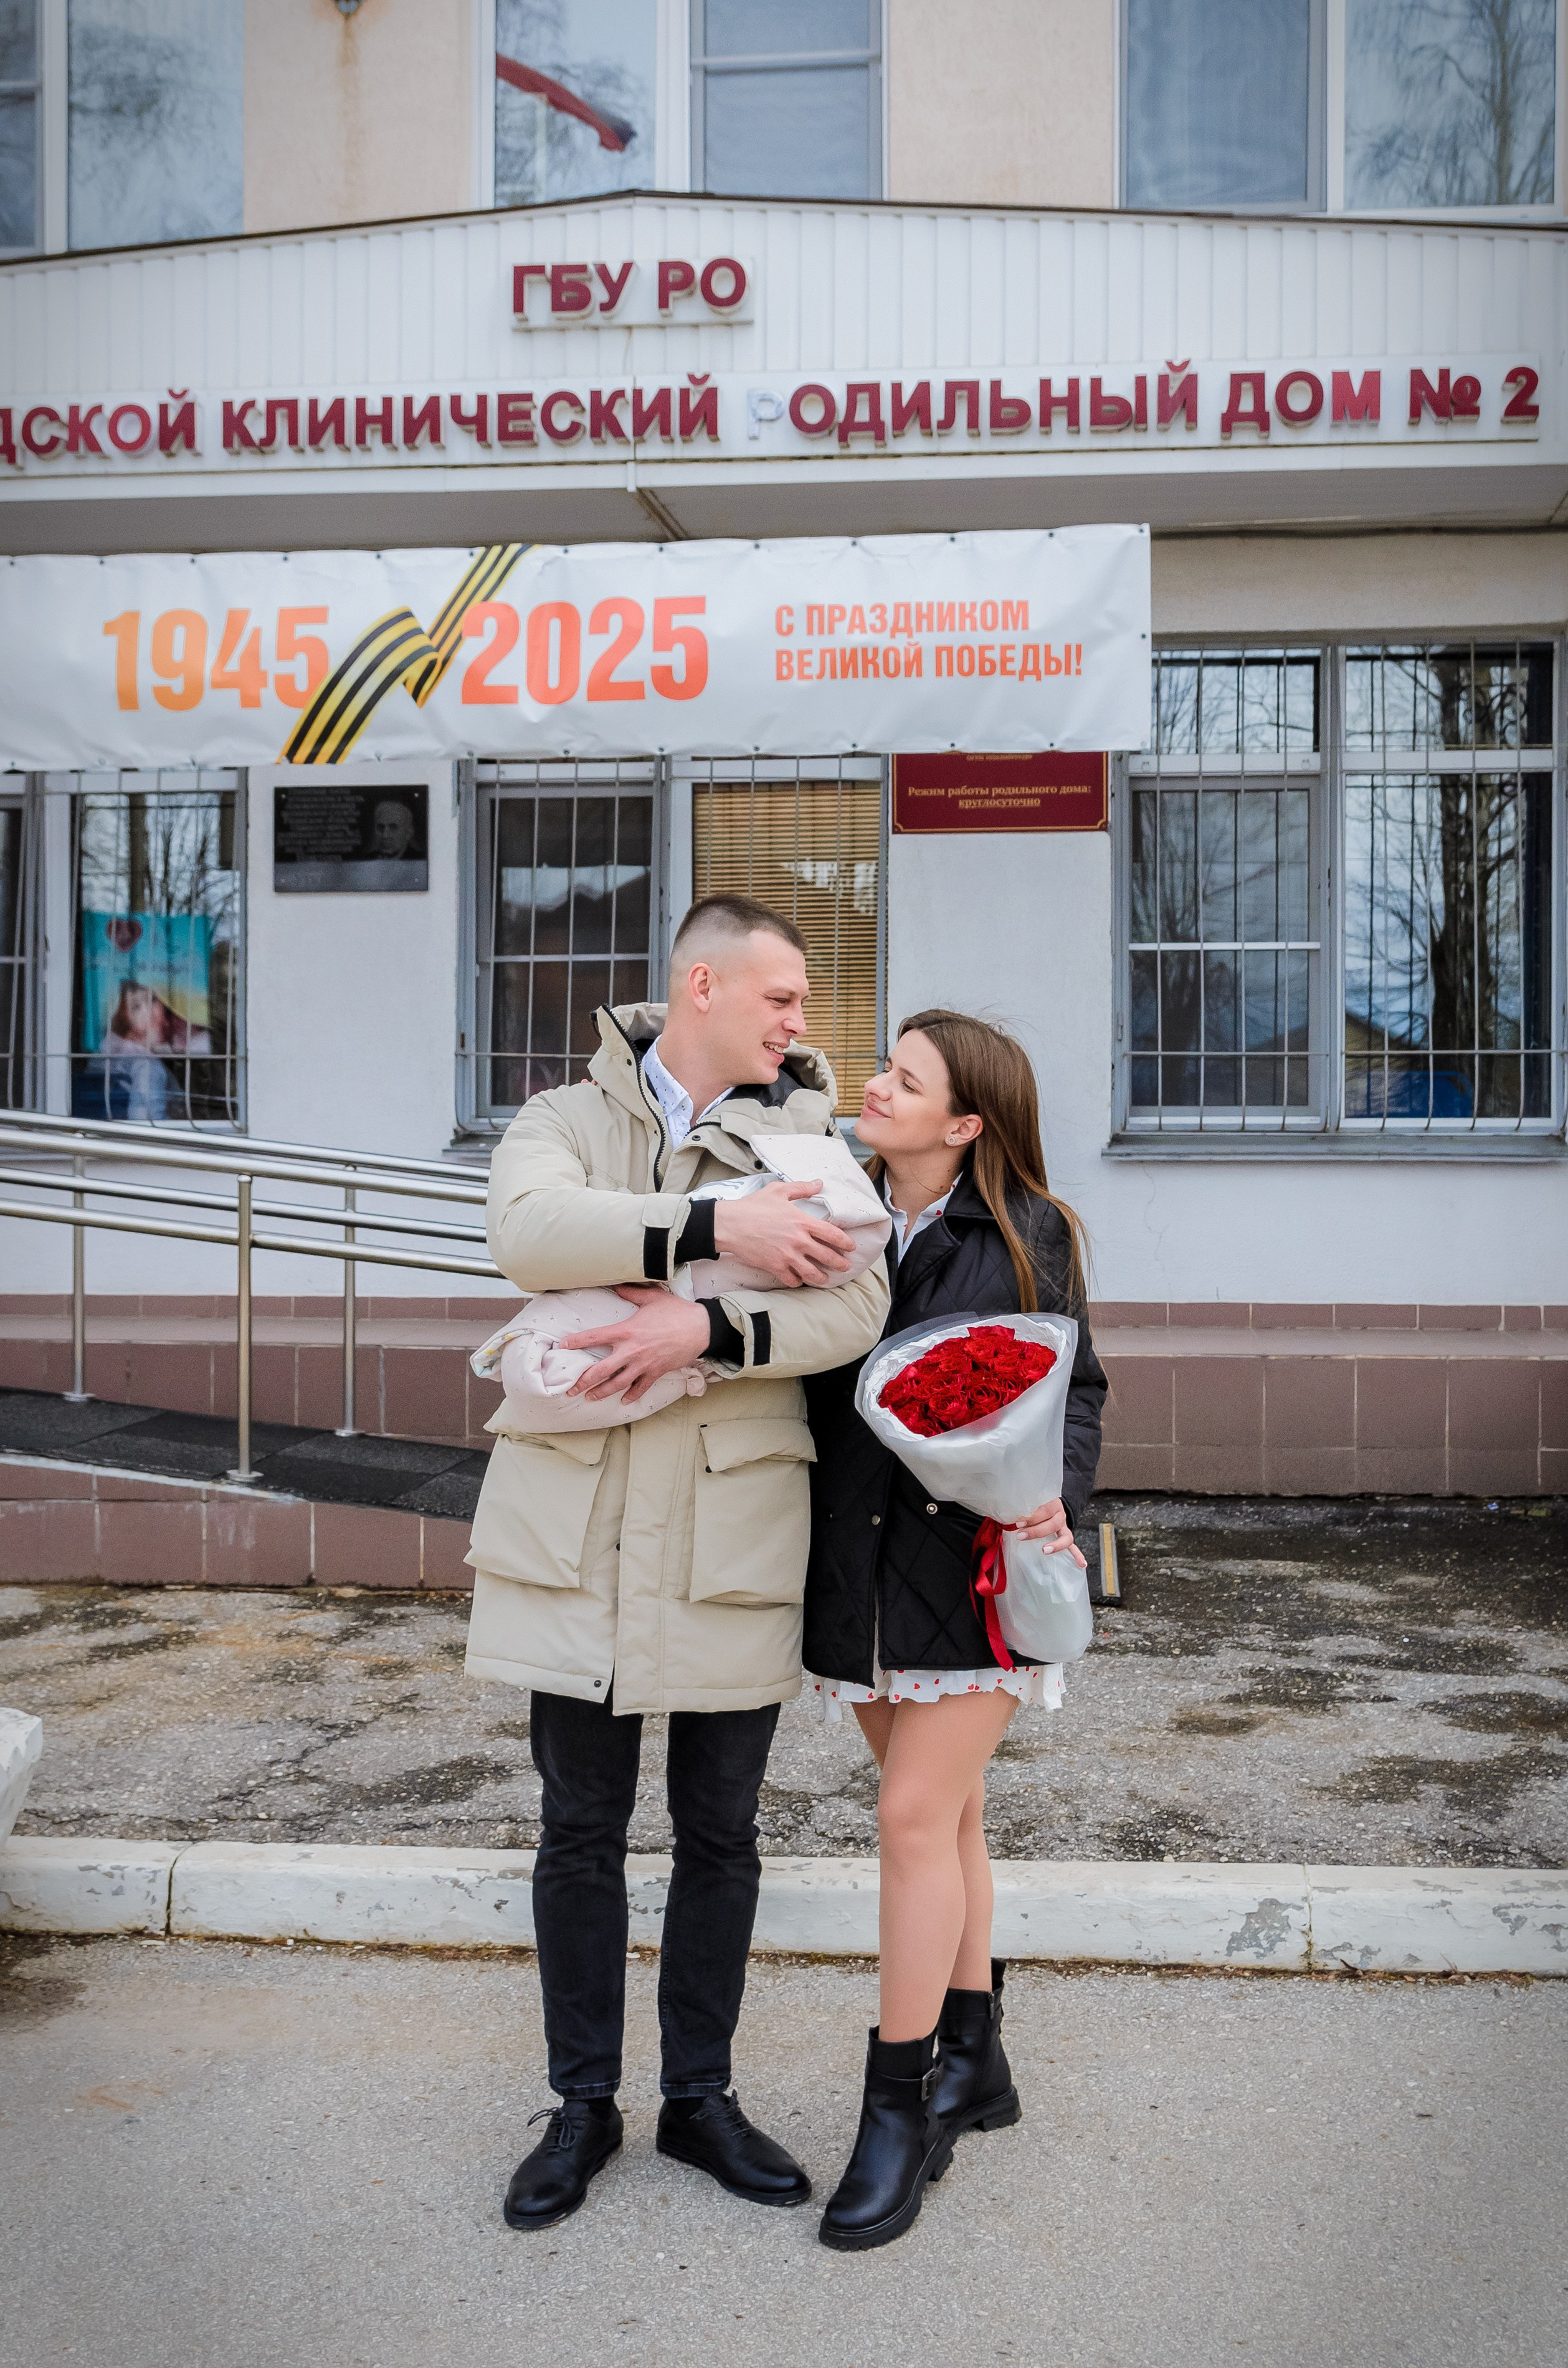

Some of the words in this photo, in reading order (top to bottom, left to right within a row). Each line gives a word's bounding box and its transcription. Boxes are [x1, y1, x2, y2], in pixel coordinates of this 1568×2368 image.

[513, 262, 634, 314] ГБУ
[658, 257, 748, 310] РО
[222, 374, 718, 449] КЛИНИЧЕСКИЙ
[748, 360, 1199, 444] РОДИЛЬНЫЙ
[1220, 370, 1382, 434] ДОМ
[1409, 368, 1481, 419] №
[1503, 366, 1540, 418] 2
[775, 604, 795, 637] С
[805, 599, 1030, 639] ПРАЗДНИКОМ
[103, 606, 331, 712] 1945
[460, 596, 710, 706] 2025
[775, 641, 924, 682] ВЕЛИКОЙ
[934, 642, 1083, 682] ПОБЕДЫ!
[908, 786, 945, 796] Режим
[948, 785, 989, 798] работы
[992, 786, 1058, 797] родильного
[1059, 785, 1091, 795] дома:
[958, 798, 1041, 809] круглосуточно
